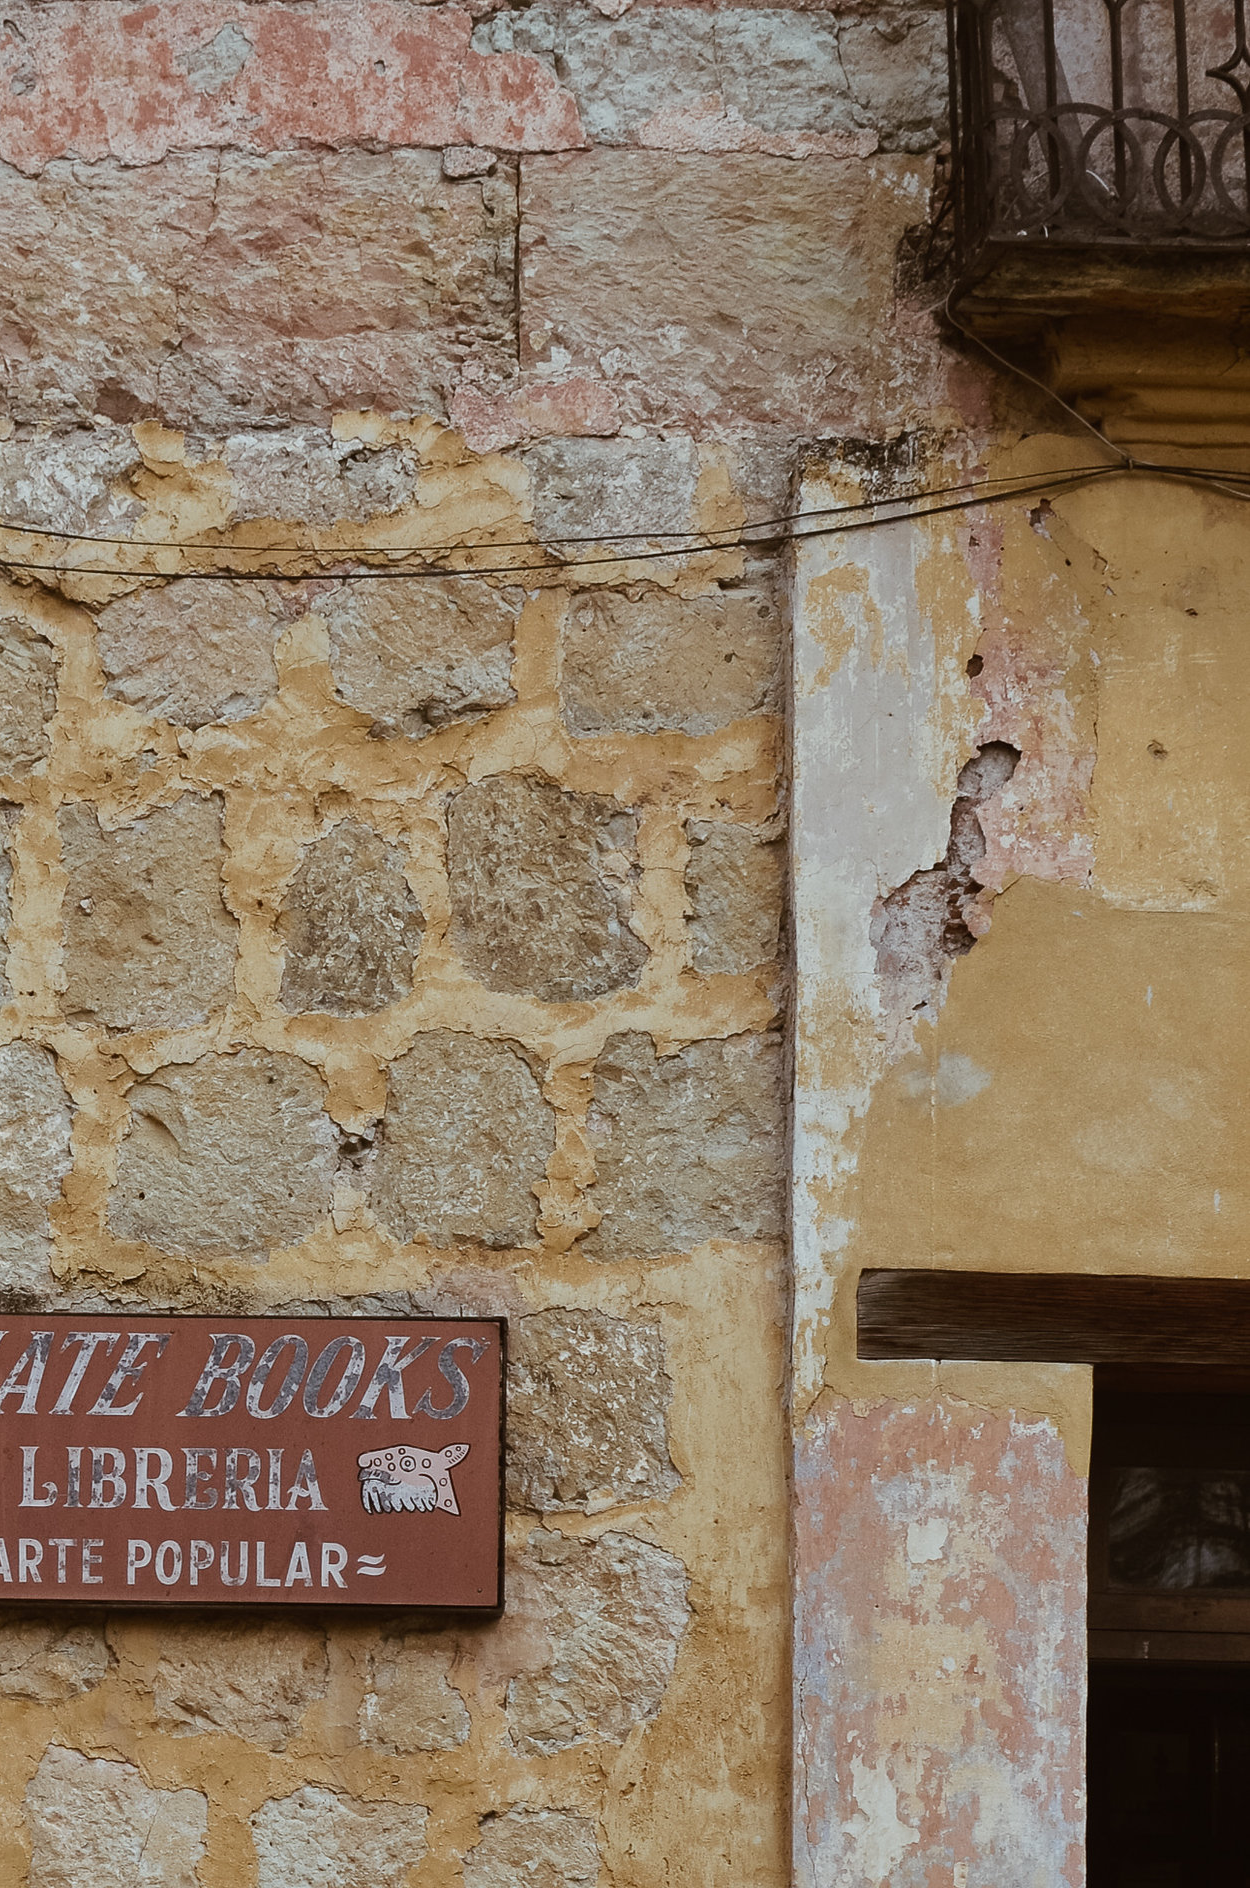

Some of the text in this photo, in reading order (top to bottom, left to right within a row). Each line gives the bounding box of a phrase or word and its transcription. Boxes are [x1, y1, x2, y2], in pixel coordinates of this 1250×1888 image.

[176, 1333, 492, 1421] BOOKS
[17, 1445, 329, 1512] LIBRERIA
[127, 1540, 349, 1589] POPULAR
